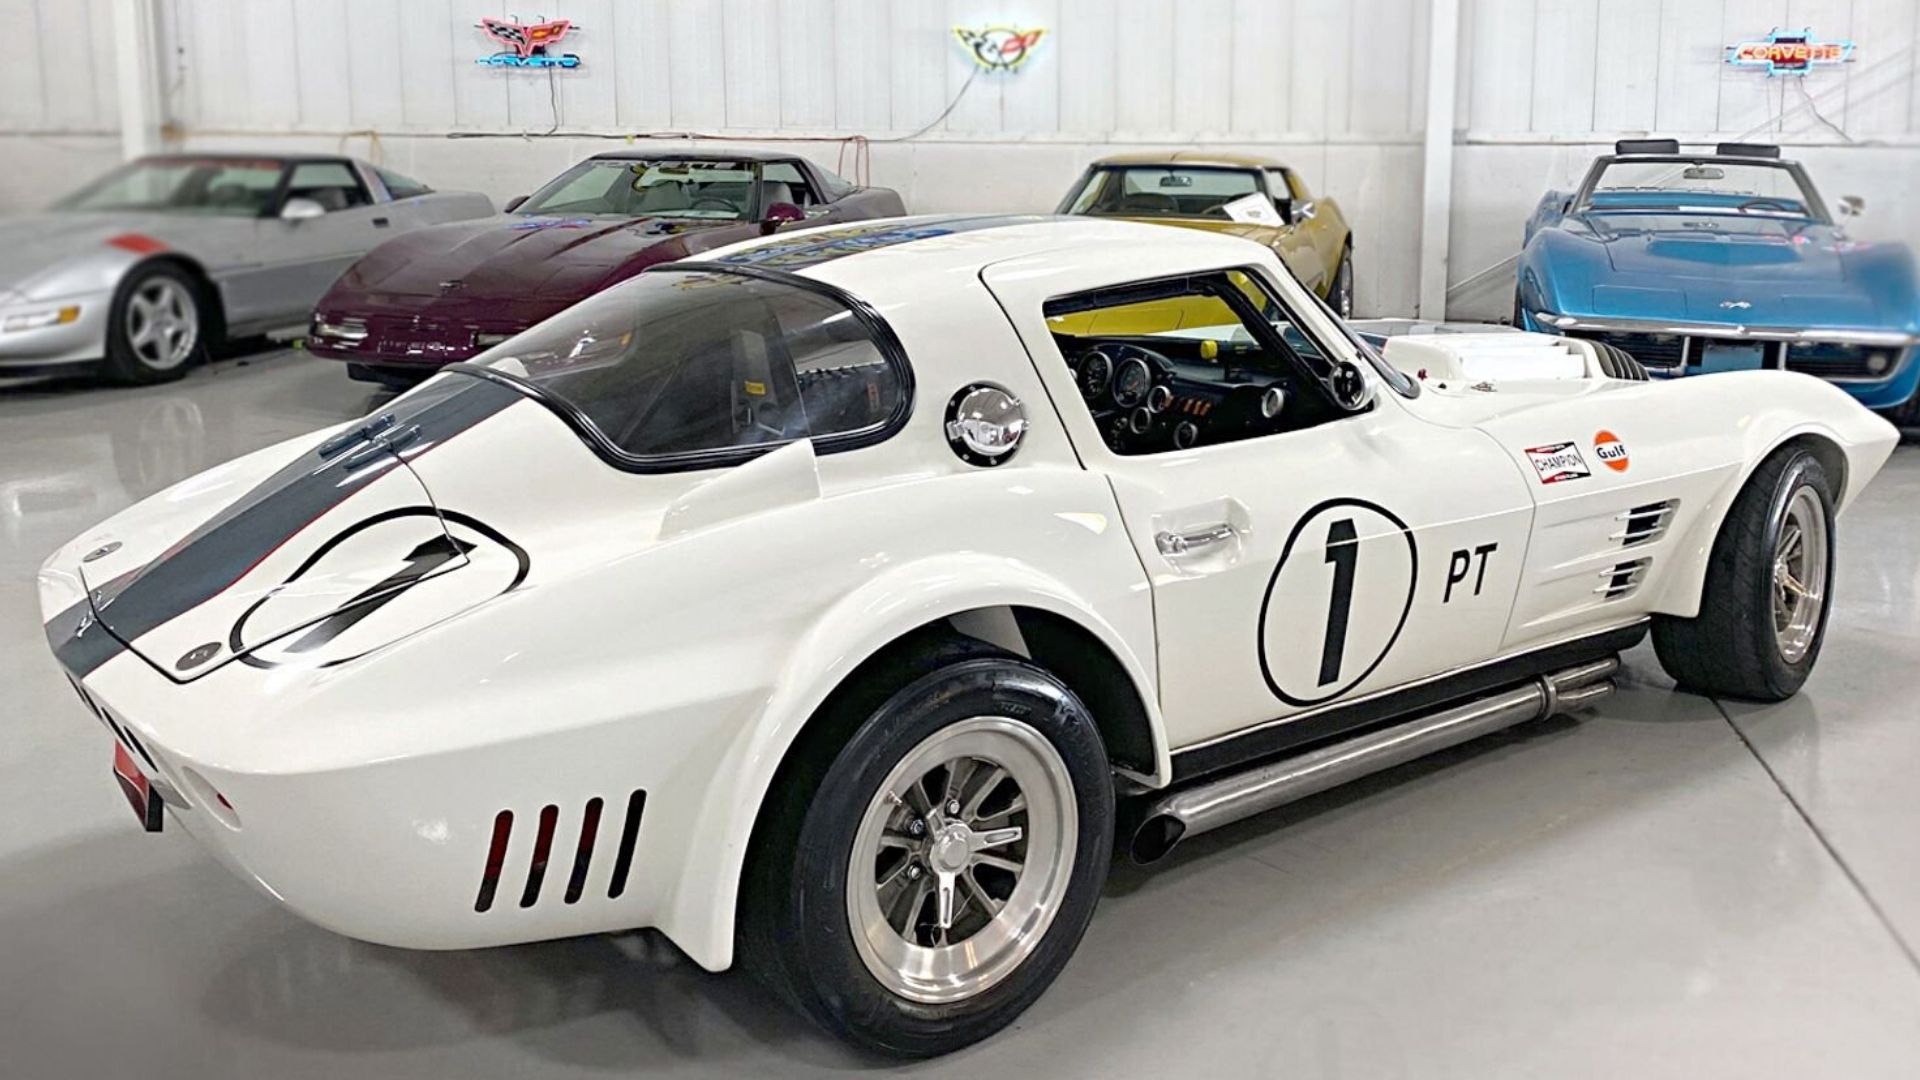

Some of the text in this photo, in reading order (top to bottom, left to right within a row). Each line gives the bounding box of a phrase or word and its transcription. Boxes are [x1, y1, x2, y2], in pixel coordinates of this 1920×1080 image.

[1738, 46, 1841, 60] CORVETTE
[1534, 454, 1582, 471] CHAMPION
[1597, 445, 1626, 459] Gulf
[1443, 542, 1498, 603] PT
[281, 533, 478, 653] 1
[1317, 518, 1359, 688] 1
